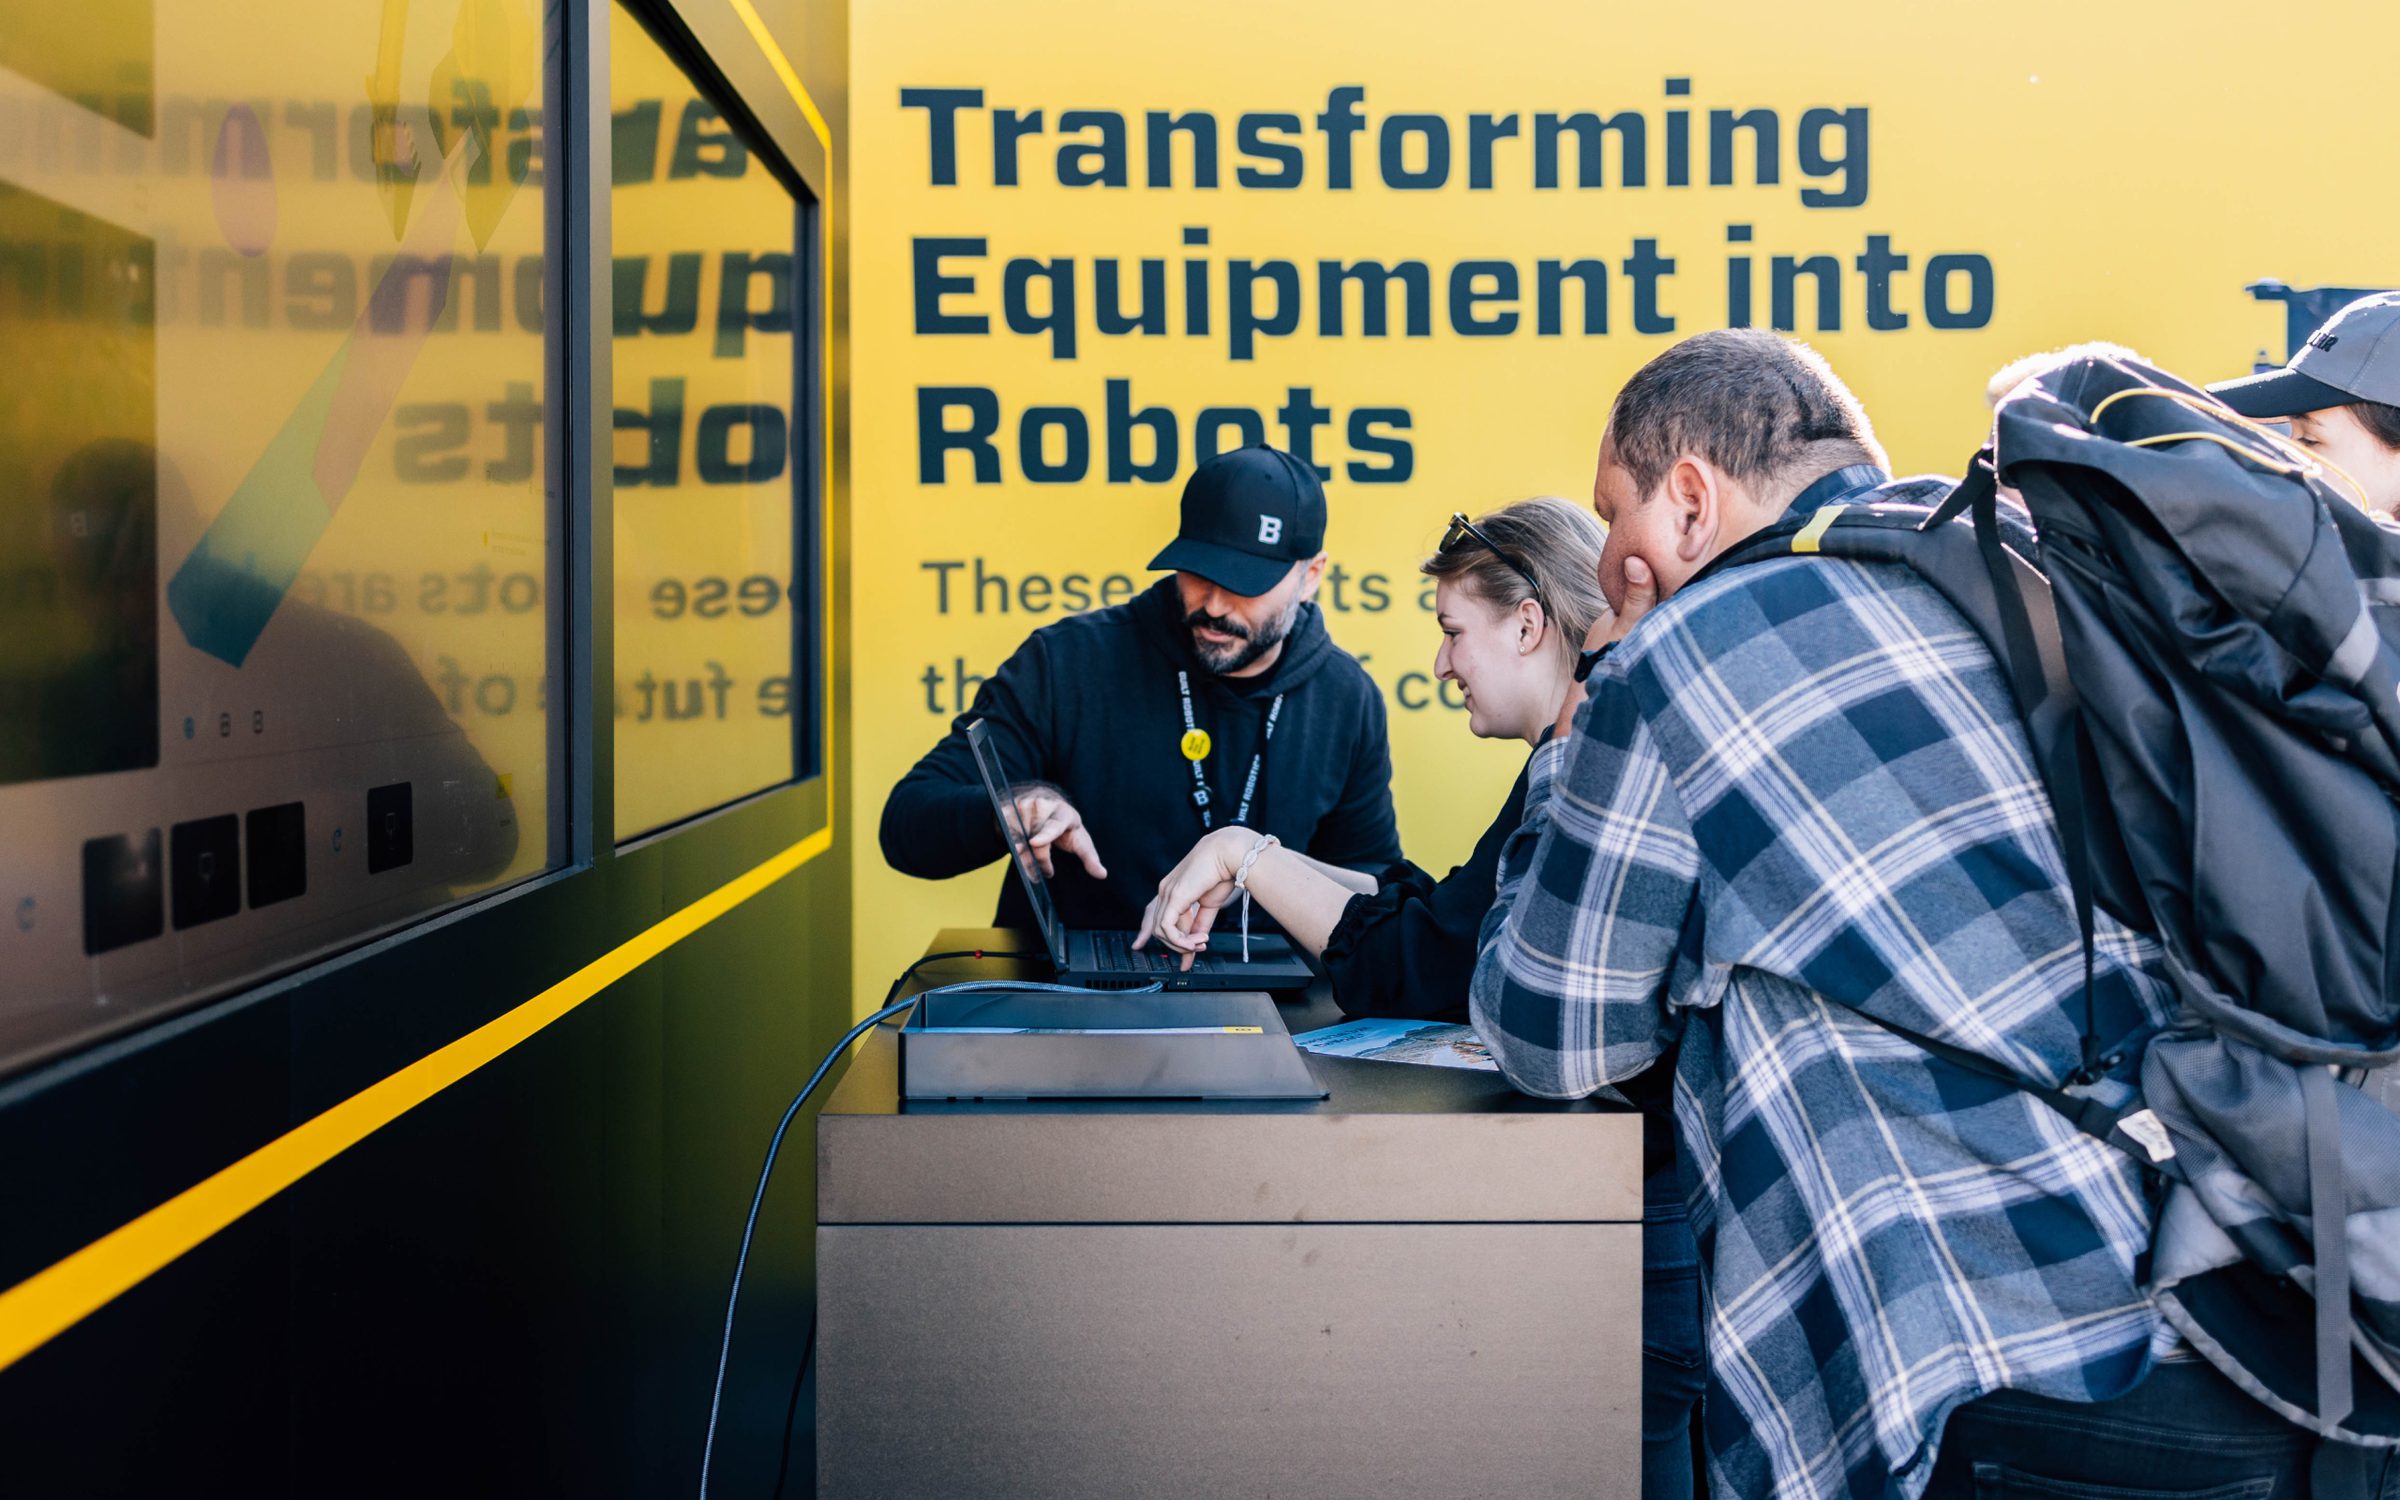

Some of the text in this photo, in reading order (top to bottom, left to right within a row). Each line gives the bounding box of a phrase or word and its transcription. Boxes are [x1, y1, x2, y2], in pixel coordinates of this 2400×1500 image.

[900, 78, 1870, 208] Transforming
[912, 224, 1994, 361] Equipment into
[1258, 514, 1283, 545] B
[920, 557, 1135, 614] These
